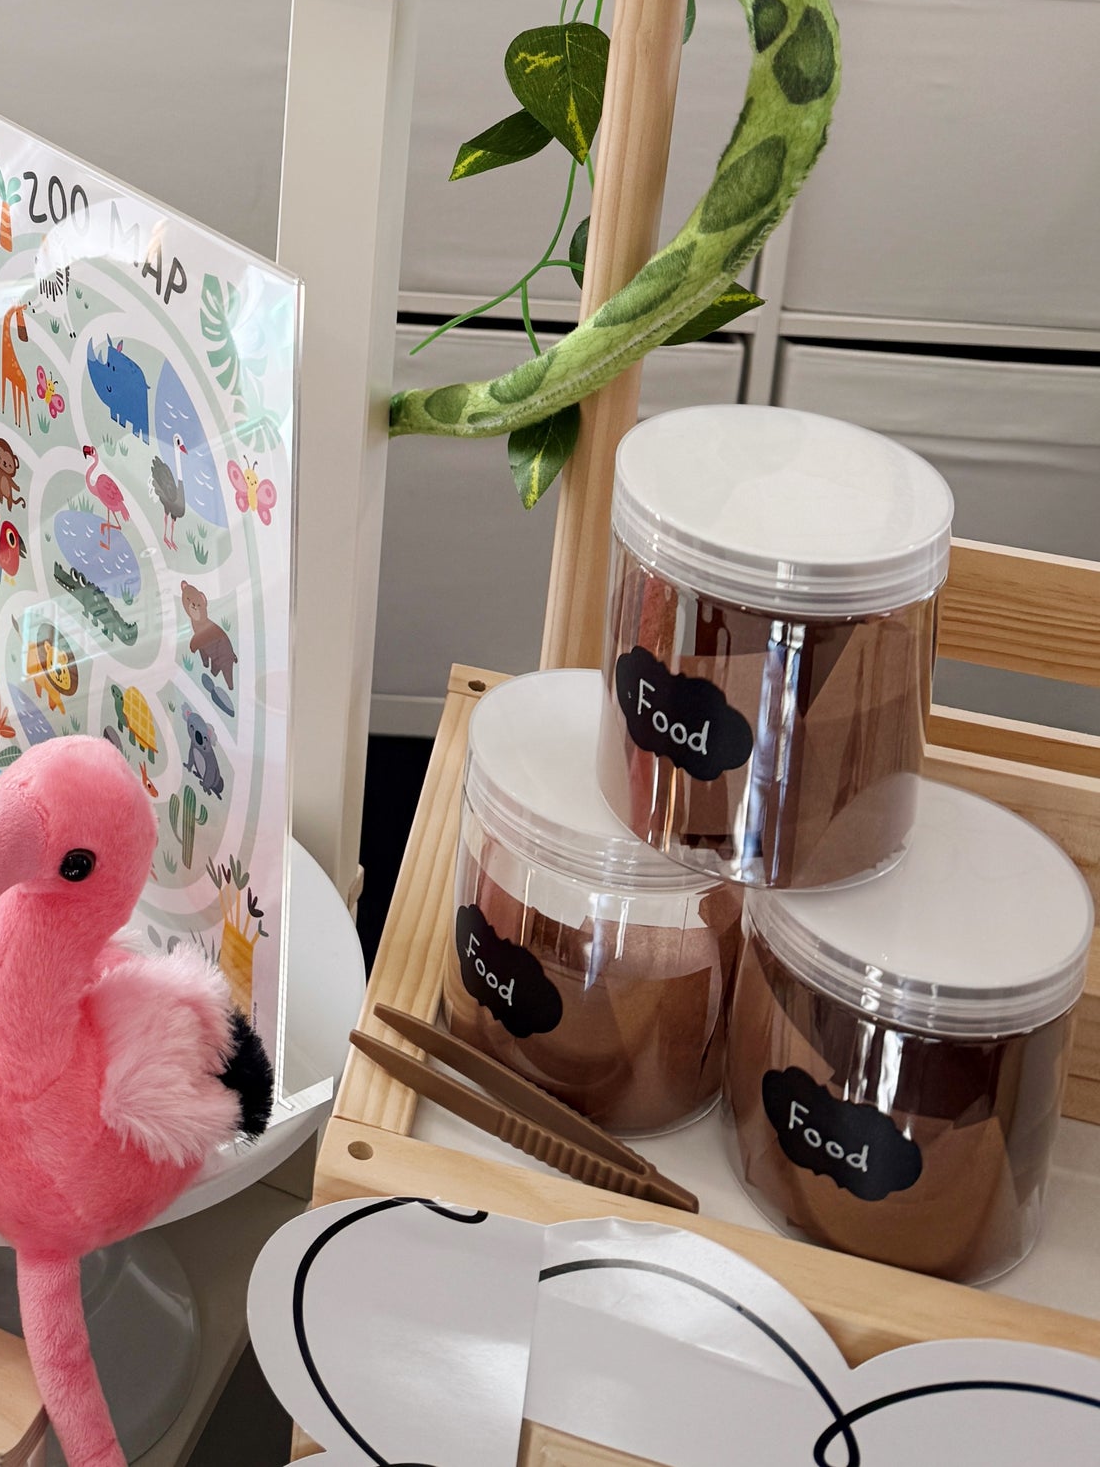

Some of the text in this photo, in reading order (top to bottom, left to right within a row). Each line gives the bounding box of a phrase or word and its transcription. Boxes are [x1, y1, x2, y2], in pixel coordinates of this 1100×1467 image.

[23, 171, 188, 305] ZOO MAP
[636, 679, 710, 756] Food
[465, 934, 515, 1006] Food
[788, 1100, 870, 1172] Food
